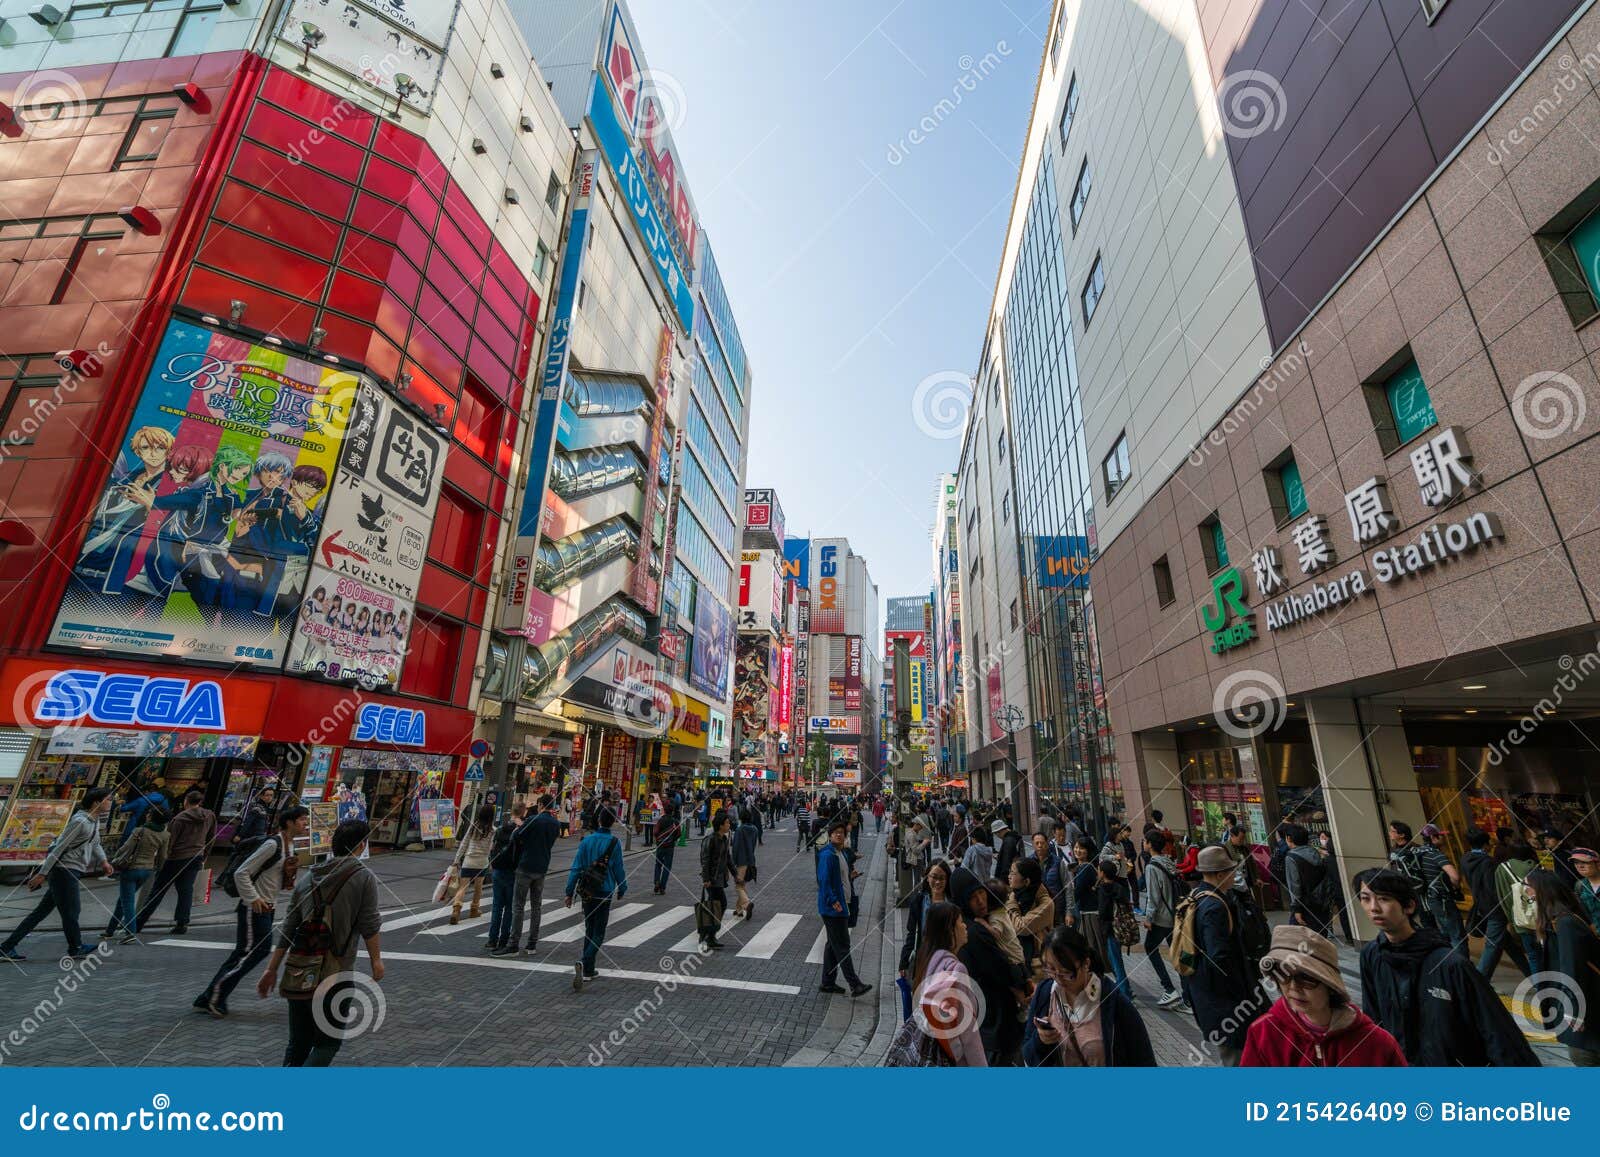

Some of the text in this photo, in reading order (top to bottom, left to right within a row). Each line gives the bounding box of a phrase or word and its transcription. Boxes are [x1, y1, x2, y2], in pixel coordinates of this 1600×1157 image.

[542, 316, 570, 401] パソコン館
[1421, 412, 1435, 429] 2F
[340, 470, 360, 490] 7F
[391, 430, 428, 490] 牛角
[1251, 426, 1474, 595] 秋葉原駅
[741, 552, 760, 562] SLOT
[1265, 511, 1494, 632] Akihabara Station
[513, 572, 527, 606] LABI
[1202, 567, 1249, 632] JR
[234, 645, 274, 660] SEGA
[851, 658, 859, 677] Free
[37, 670, 226, 730] SEGA
[355, 704, 426, 747] SEGA
